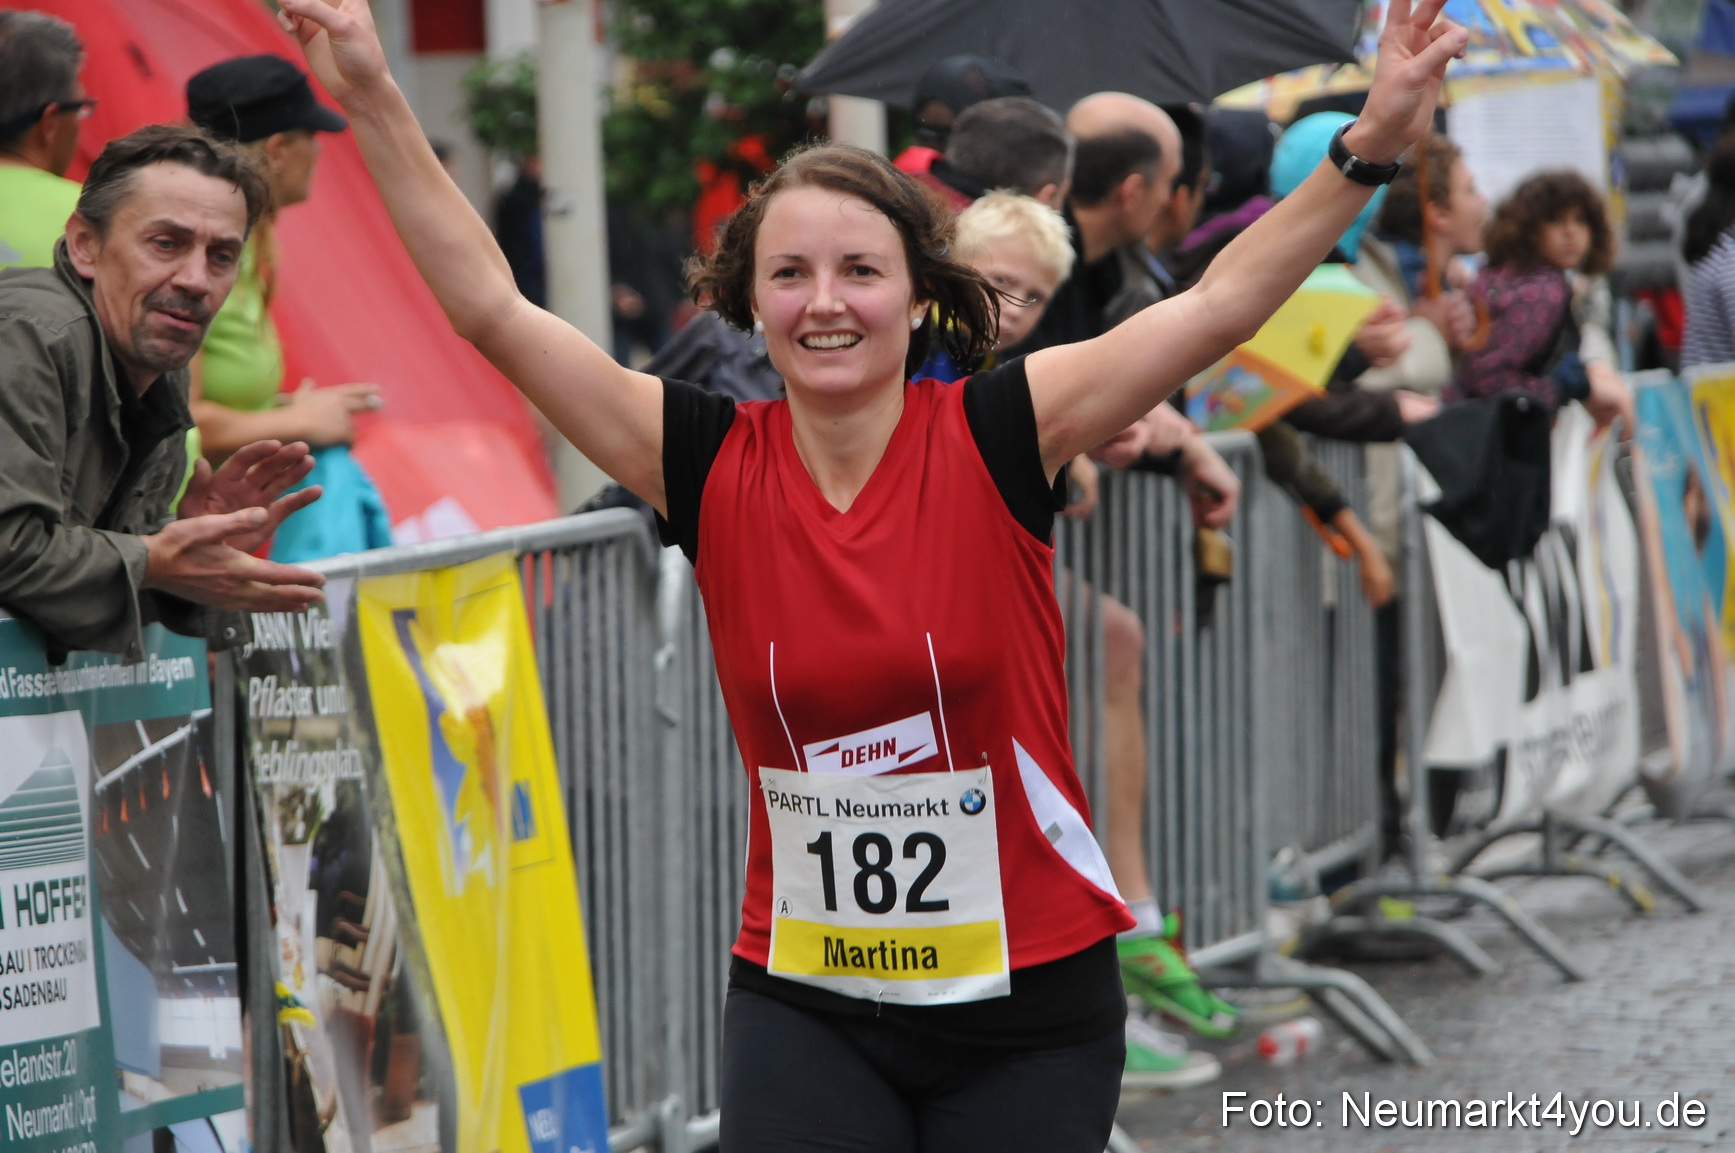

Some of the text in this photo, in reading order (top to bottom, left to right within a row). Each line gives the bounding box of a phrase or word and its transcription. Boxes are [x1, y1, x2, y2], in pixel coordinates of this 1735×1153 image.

[149, 652, 195, 690] Bayern
[250, 675, 314, 718] Pflaster
[841, 736, 897, 768] DEHN
[768, 789, 950, 818] PARTL Neumarkt
[806, 831, 950, 915] 182
[823, 935, 939, 970] Martina
